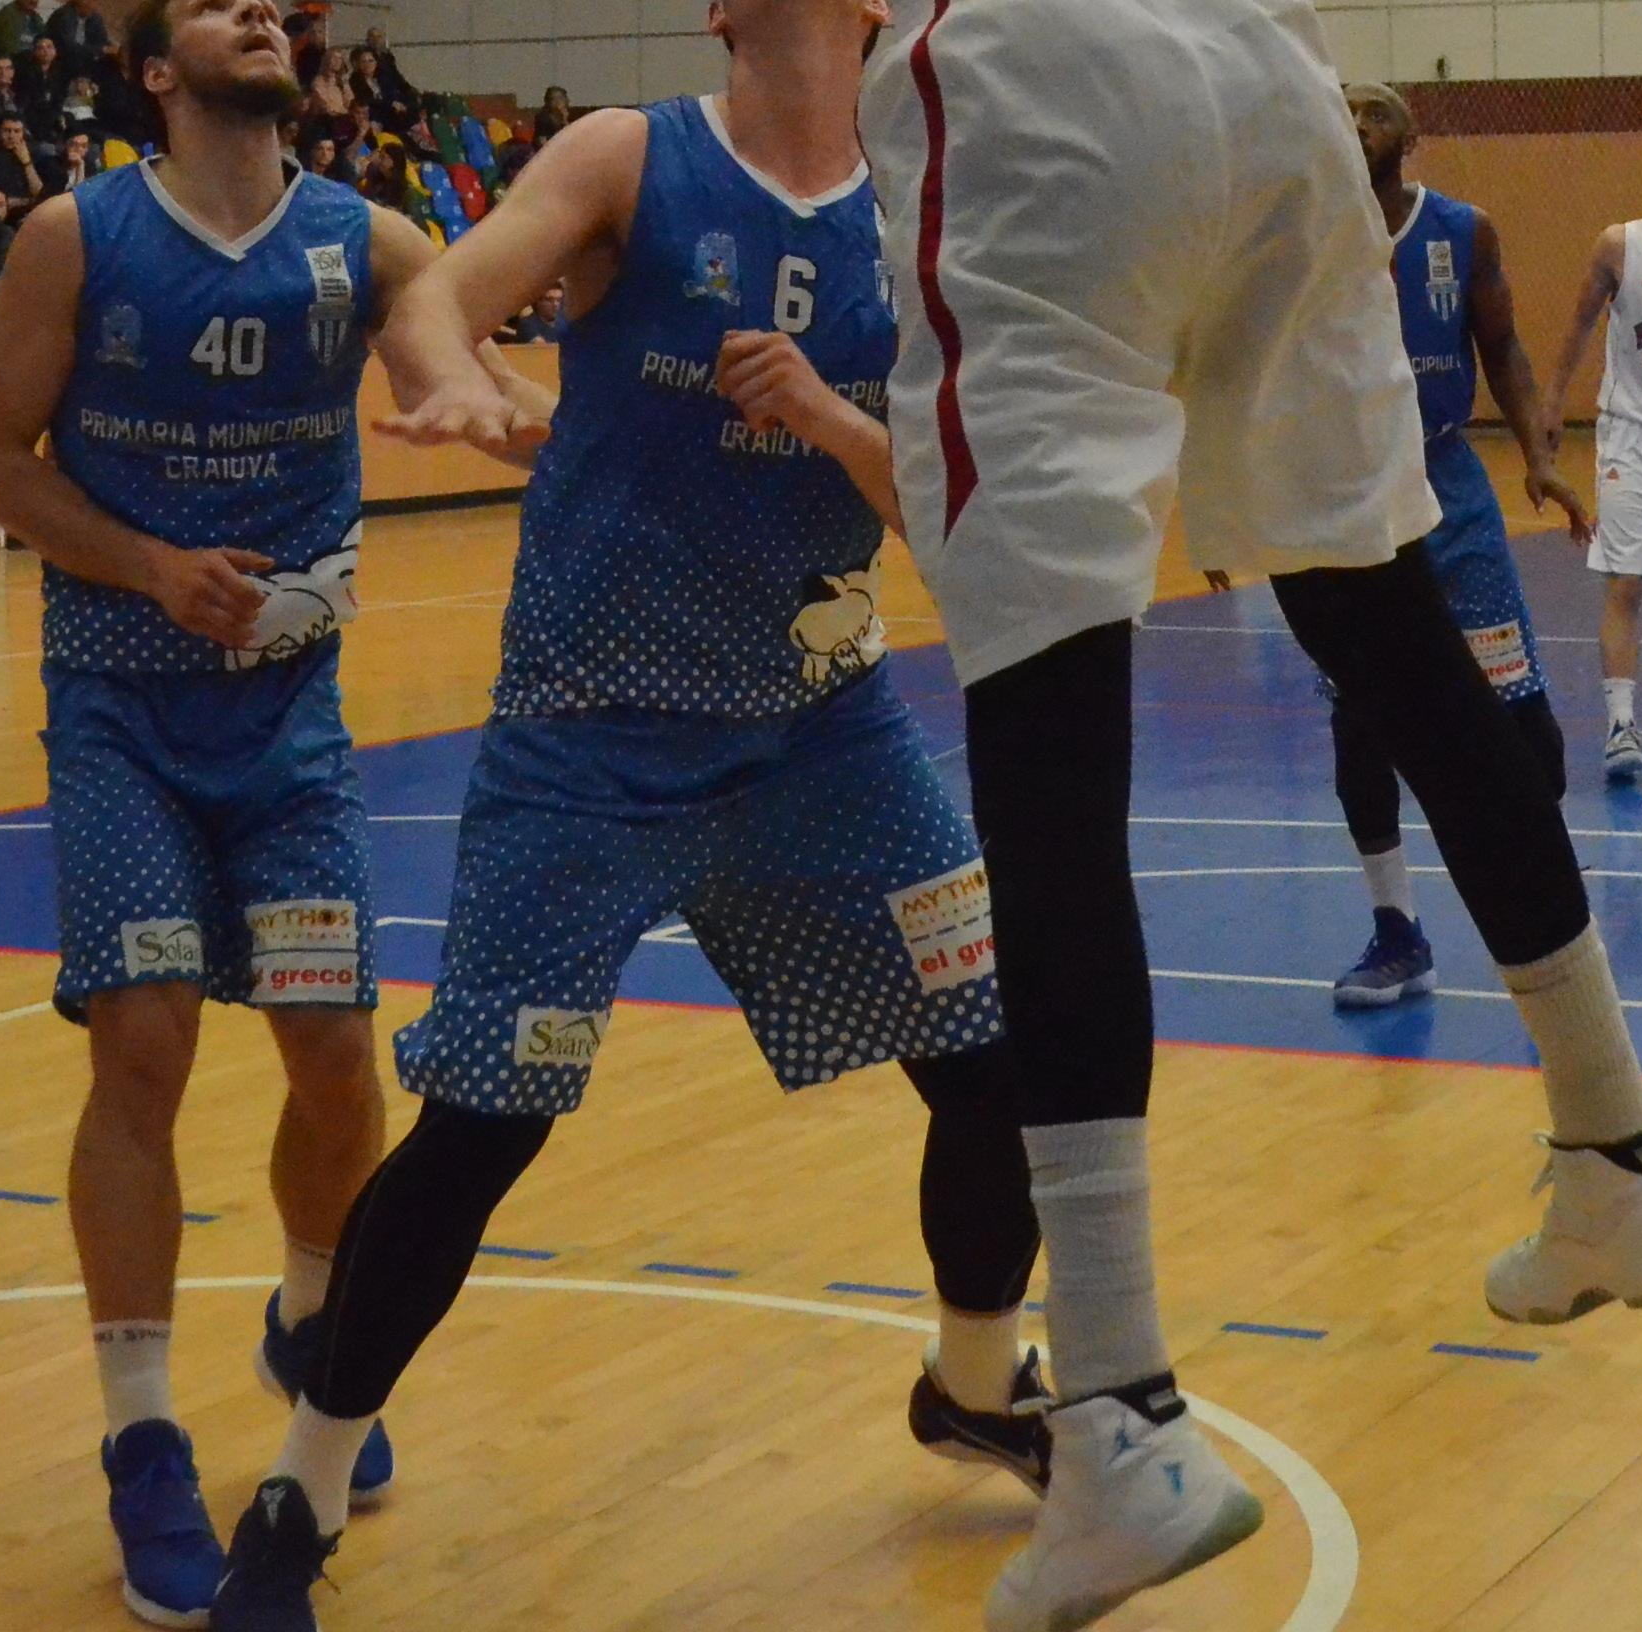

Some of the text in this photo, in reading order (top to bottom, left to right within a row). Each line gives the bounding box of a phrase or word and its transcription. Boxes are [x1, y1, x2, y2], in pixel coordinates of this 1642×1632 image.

[772, 254, 817, 334] 6
[190, 315, 267, 376] 40
[80, 407, 197, 448] PRIMARIA
[1488, 659, 1526, 677] reco
[901, 869, 986, 916] MYTHO
[919, 934, 994, 974] el gre
[271, 968, 353, 990] greco
